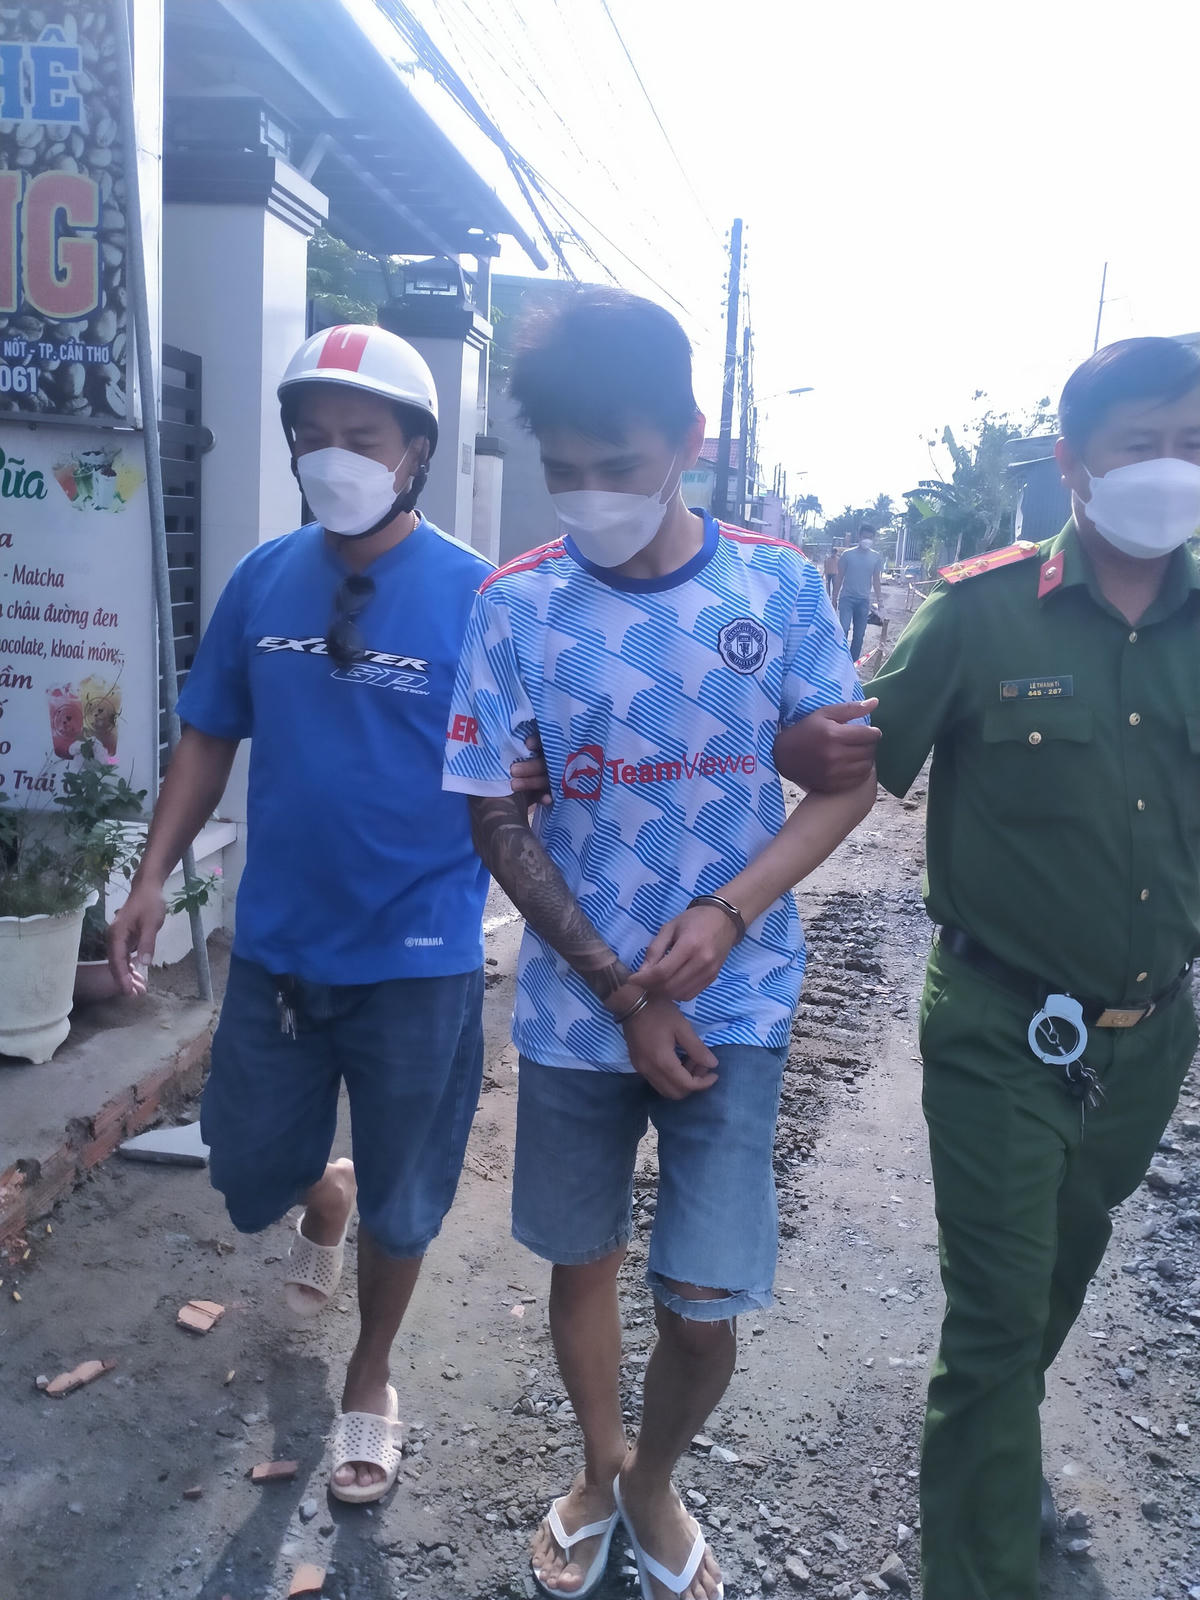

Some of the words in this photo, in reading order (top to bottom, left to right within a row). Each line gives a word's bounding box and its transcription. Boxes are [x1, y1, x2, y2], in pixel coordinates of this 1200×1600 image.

[0, 170, 99, 318] G
[4, 337, 27, 357] NỐT
[60, 338, 83, 360] CẦN
[86, 345, 110, 363] THƠ
[0, 448, 48, 499] ữa
[12, 564, 65, 588] Matcha
[7, 599, 40, 621] châu
[44, 603, 89, 629] đường
[93, 608, 118, 627] đen
[0, 635, 47, 659] ocolate,
[51, 638, 85, 659] khoai
[446, 714, 478, 745] ER
[414, 937, 444, 946] YAMAHA
